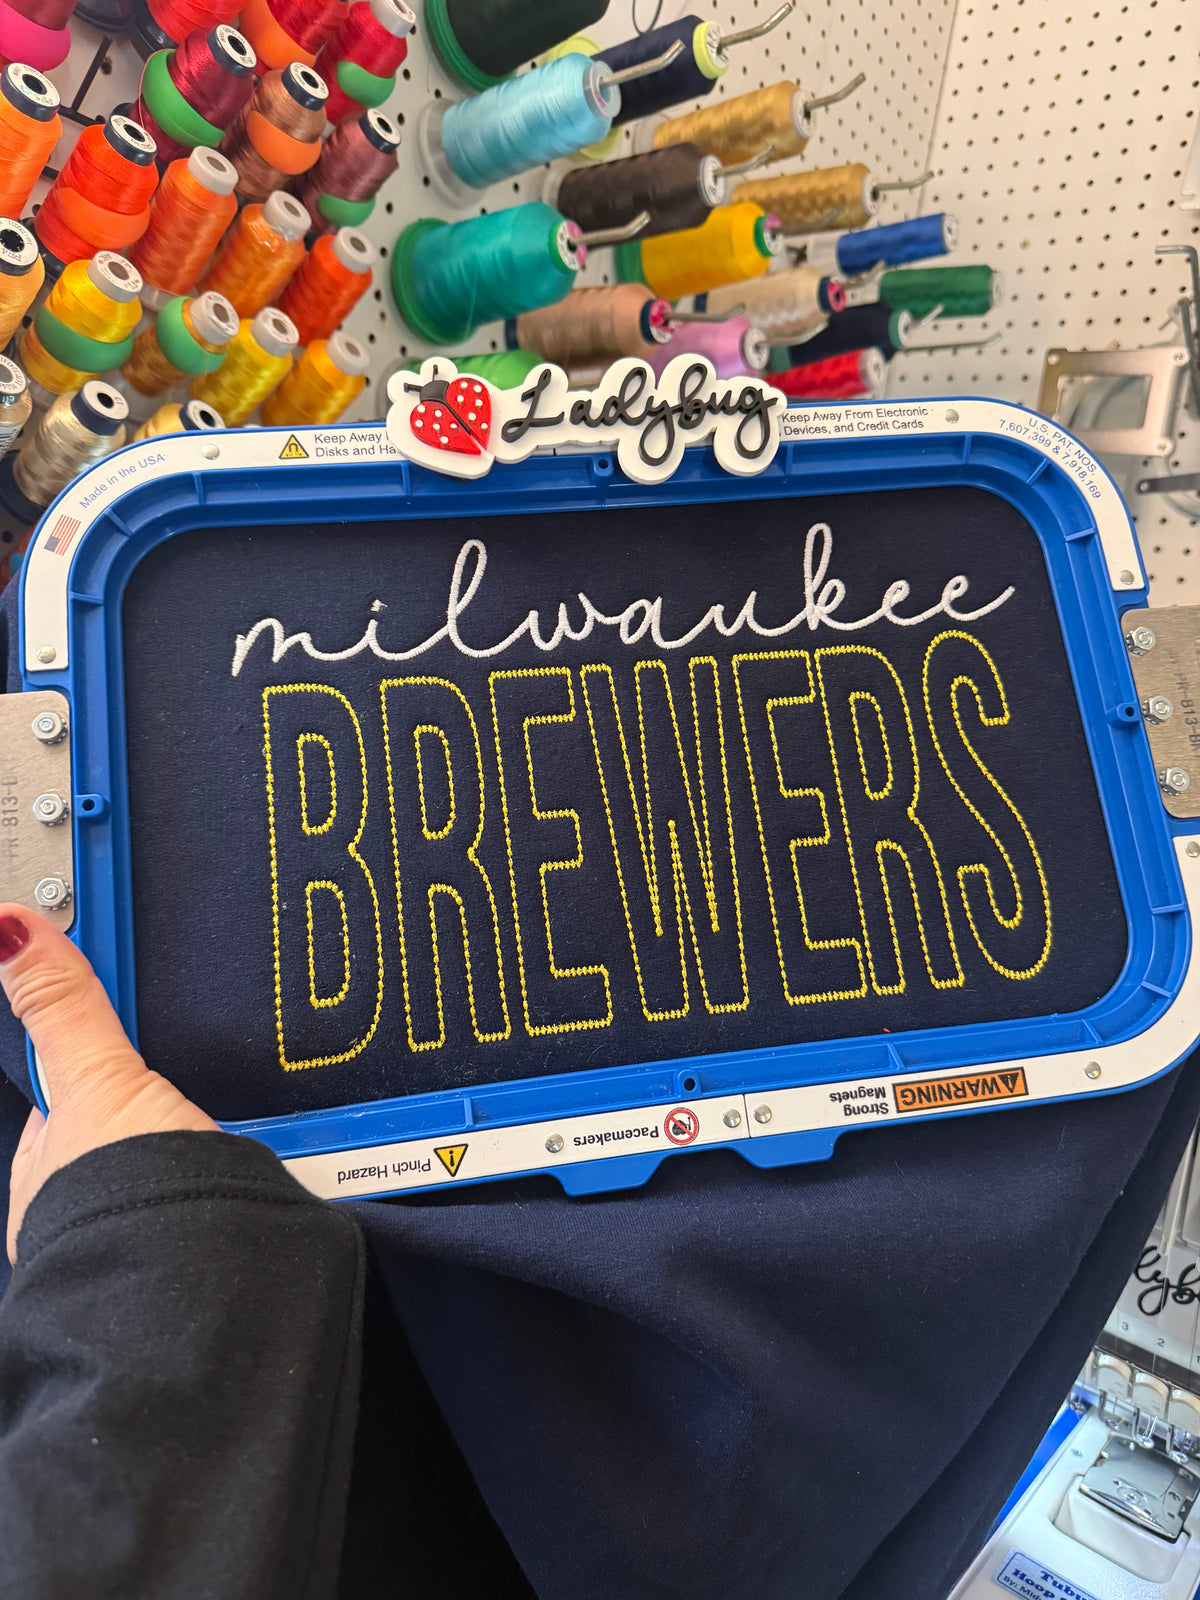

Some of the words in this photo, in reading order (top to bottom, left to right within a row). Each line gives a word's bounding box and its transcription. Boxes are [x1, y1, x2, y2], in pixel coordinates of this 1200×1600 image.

[501, 362, 779, 467] Ladybug
[781, 412, 810, 424] Keep
[812, 411, 842, 422] Away
[845, 408, 873, 420] From
[875, 406, 929, 419] Electronic
[784, 424, 831, 436] Devices,
[834, 422, 855, 433] and
[857, 420, 890, 432] Credit
[891, 418, 924, 430] Cards
[314, 433, 346, 445] Keep
[349, 432, 382, 443] Away
[1028, 417, 1050, 436] U.S.
[1052, 431, 1075, 452] PAT.
[1074, 449, 1097, 477] NOS.
[315, 446, 349, 458] Disks
[352, 444, 376, 456] and
[379, 444, 397, 455] Ha
[1051, 445, 1060, 455] &
[79, 484, 108, 509] Made
[106, 475, 119, 486] in
[118, 465, 137, 478] the
[138, 453, 166, 469] USA
[231, 522, 1017, 677] milwaukee
[262, 630, 1054, 1071] BREWERS
[829, 1086, 887, 1103] Magnets
[900, 1075, 1002, 1107] WARNING
[843, 1101, 889, 1117] Strong
[573, 1125, 660, 1147] Pacemakers
[337, 1164, 389, 1185] Hazard
[391, 1158, 432, 1177] Pinch
[1121, 1321, 1129, 1331] 3
[1157, 1337, 1166, 1348] 2
[1012, 1568, 1056, 1599] Hoop
[1020, 1585, 1043, 1600] Mid
